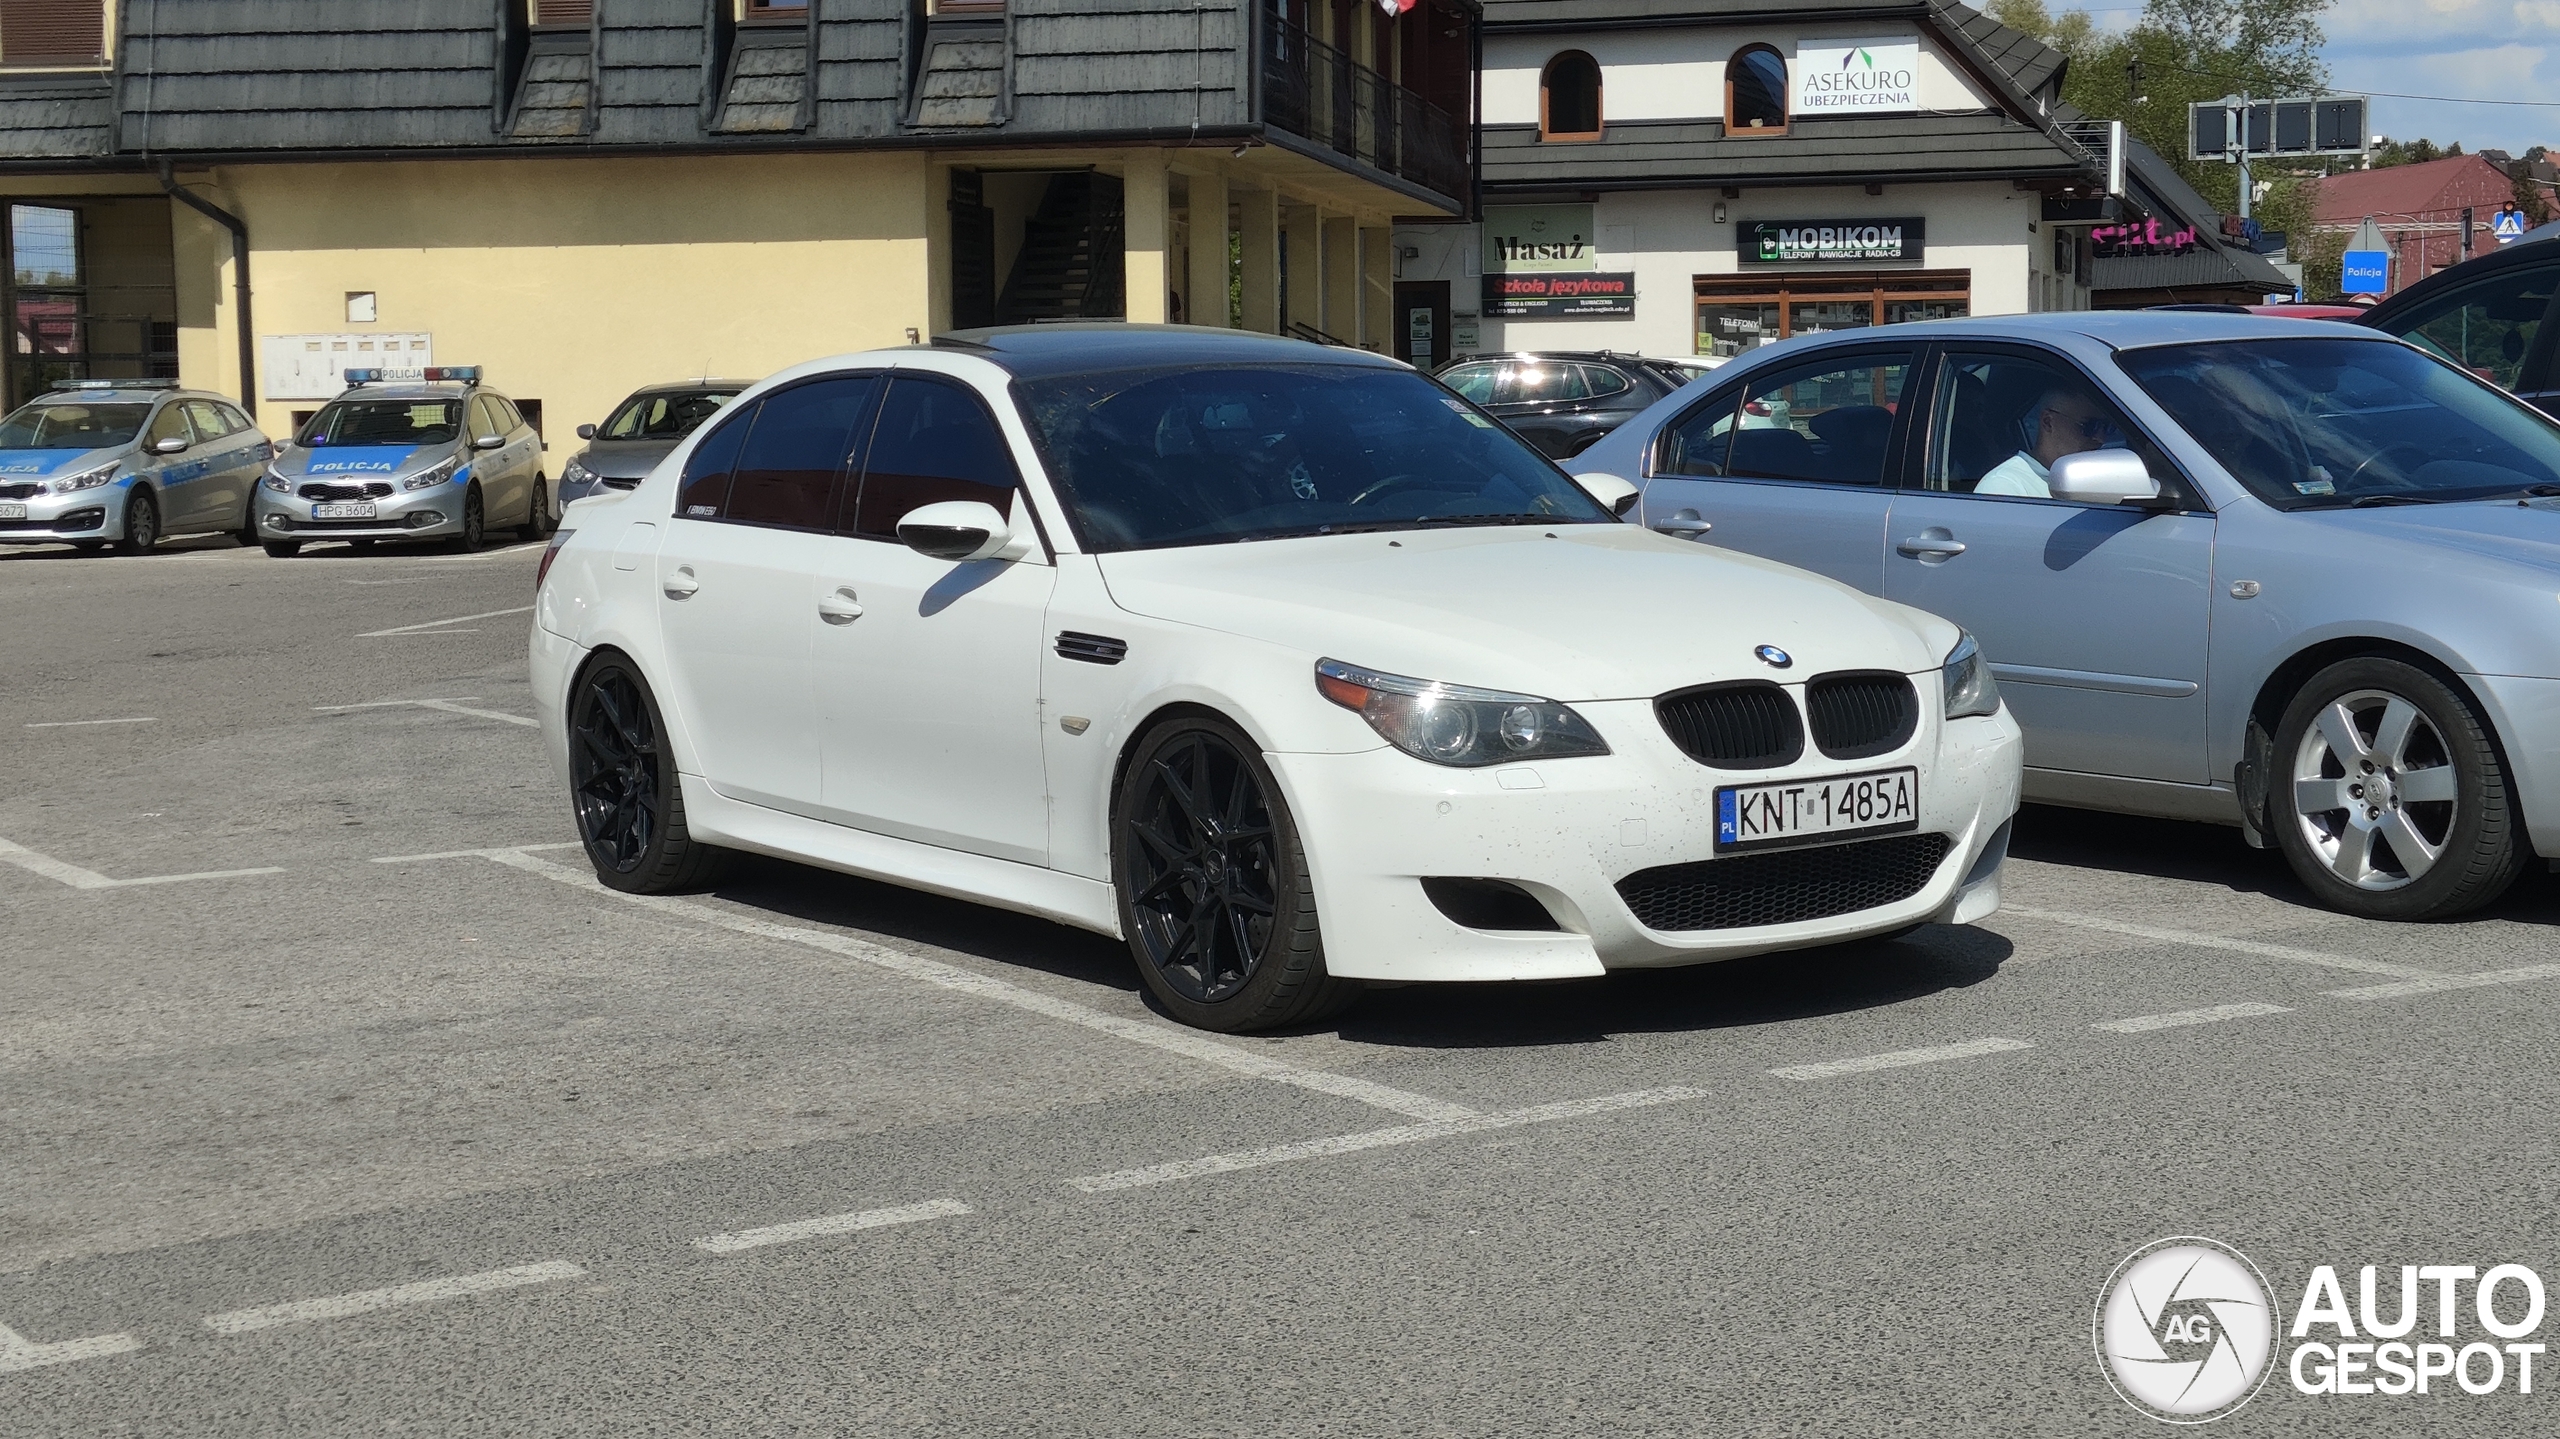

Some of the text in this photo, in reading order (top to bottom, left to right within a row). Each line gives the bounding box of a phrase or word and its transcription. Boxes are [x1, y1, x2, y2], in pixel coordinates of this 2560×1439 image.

[1804, 70, 1911, 92] ASEKURO
[1804, 92, 1911, 107] UBEZPIECZENIA
[1779, 226, 1902, 250] MOBIKOM
[1493, 234, 1585, 261] Masaż
[1779, 249, 1901, 259] TELEFONY NAWIGACJE RADIA-CB
[2347, 267, 2382, 279] Policja
[1493, 278, 1625, 296] Szkoła językowa
[1719, 317, 1759, 328] TELEFONY
[382, 369, 423, 379] POLICJA
[311, 461, 391, 472] POLICJA
[319, 505, 373, 516] HPG B604
[1721, 776, 1911, 836] PL KNT 1485A
